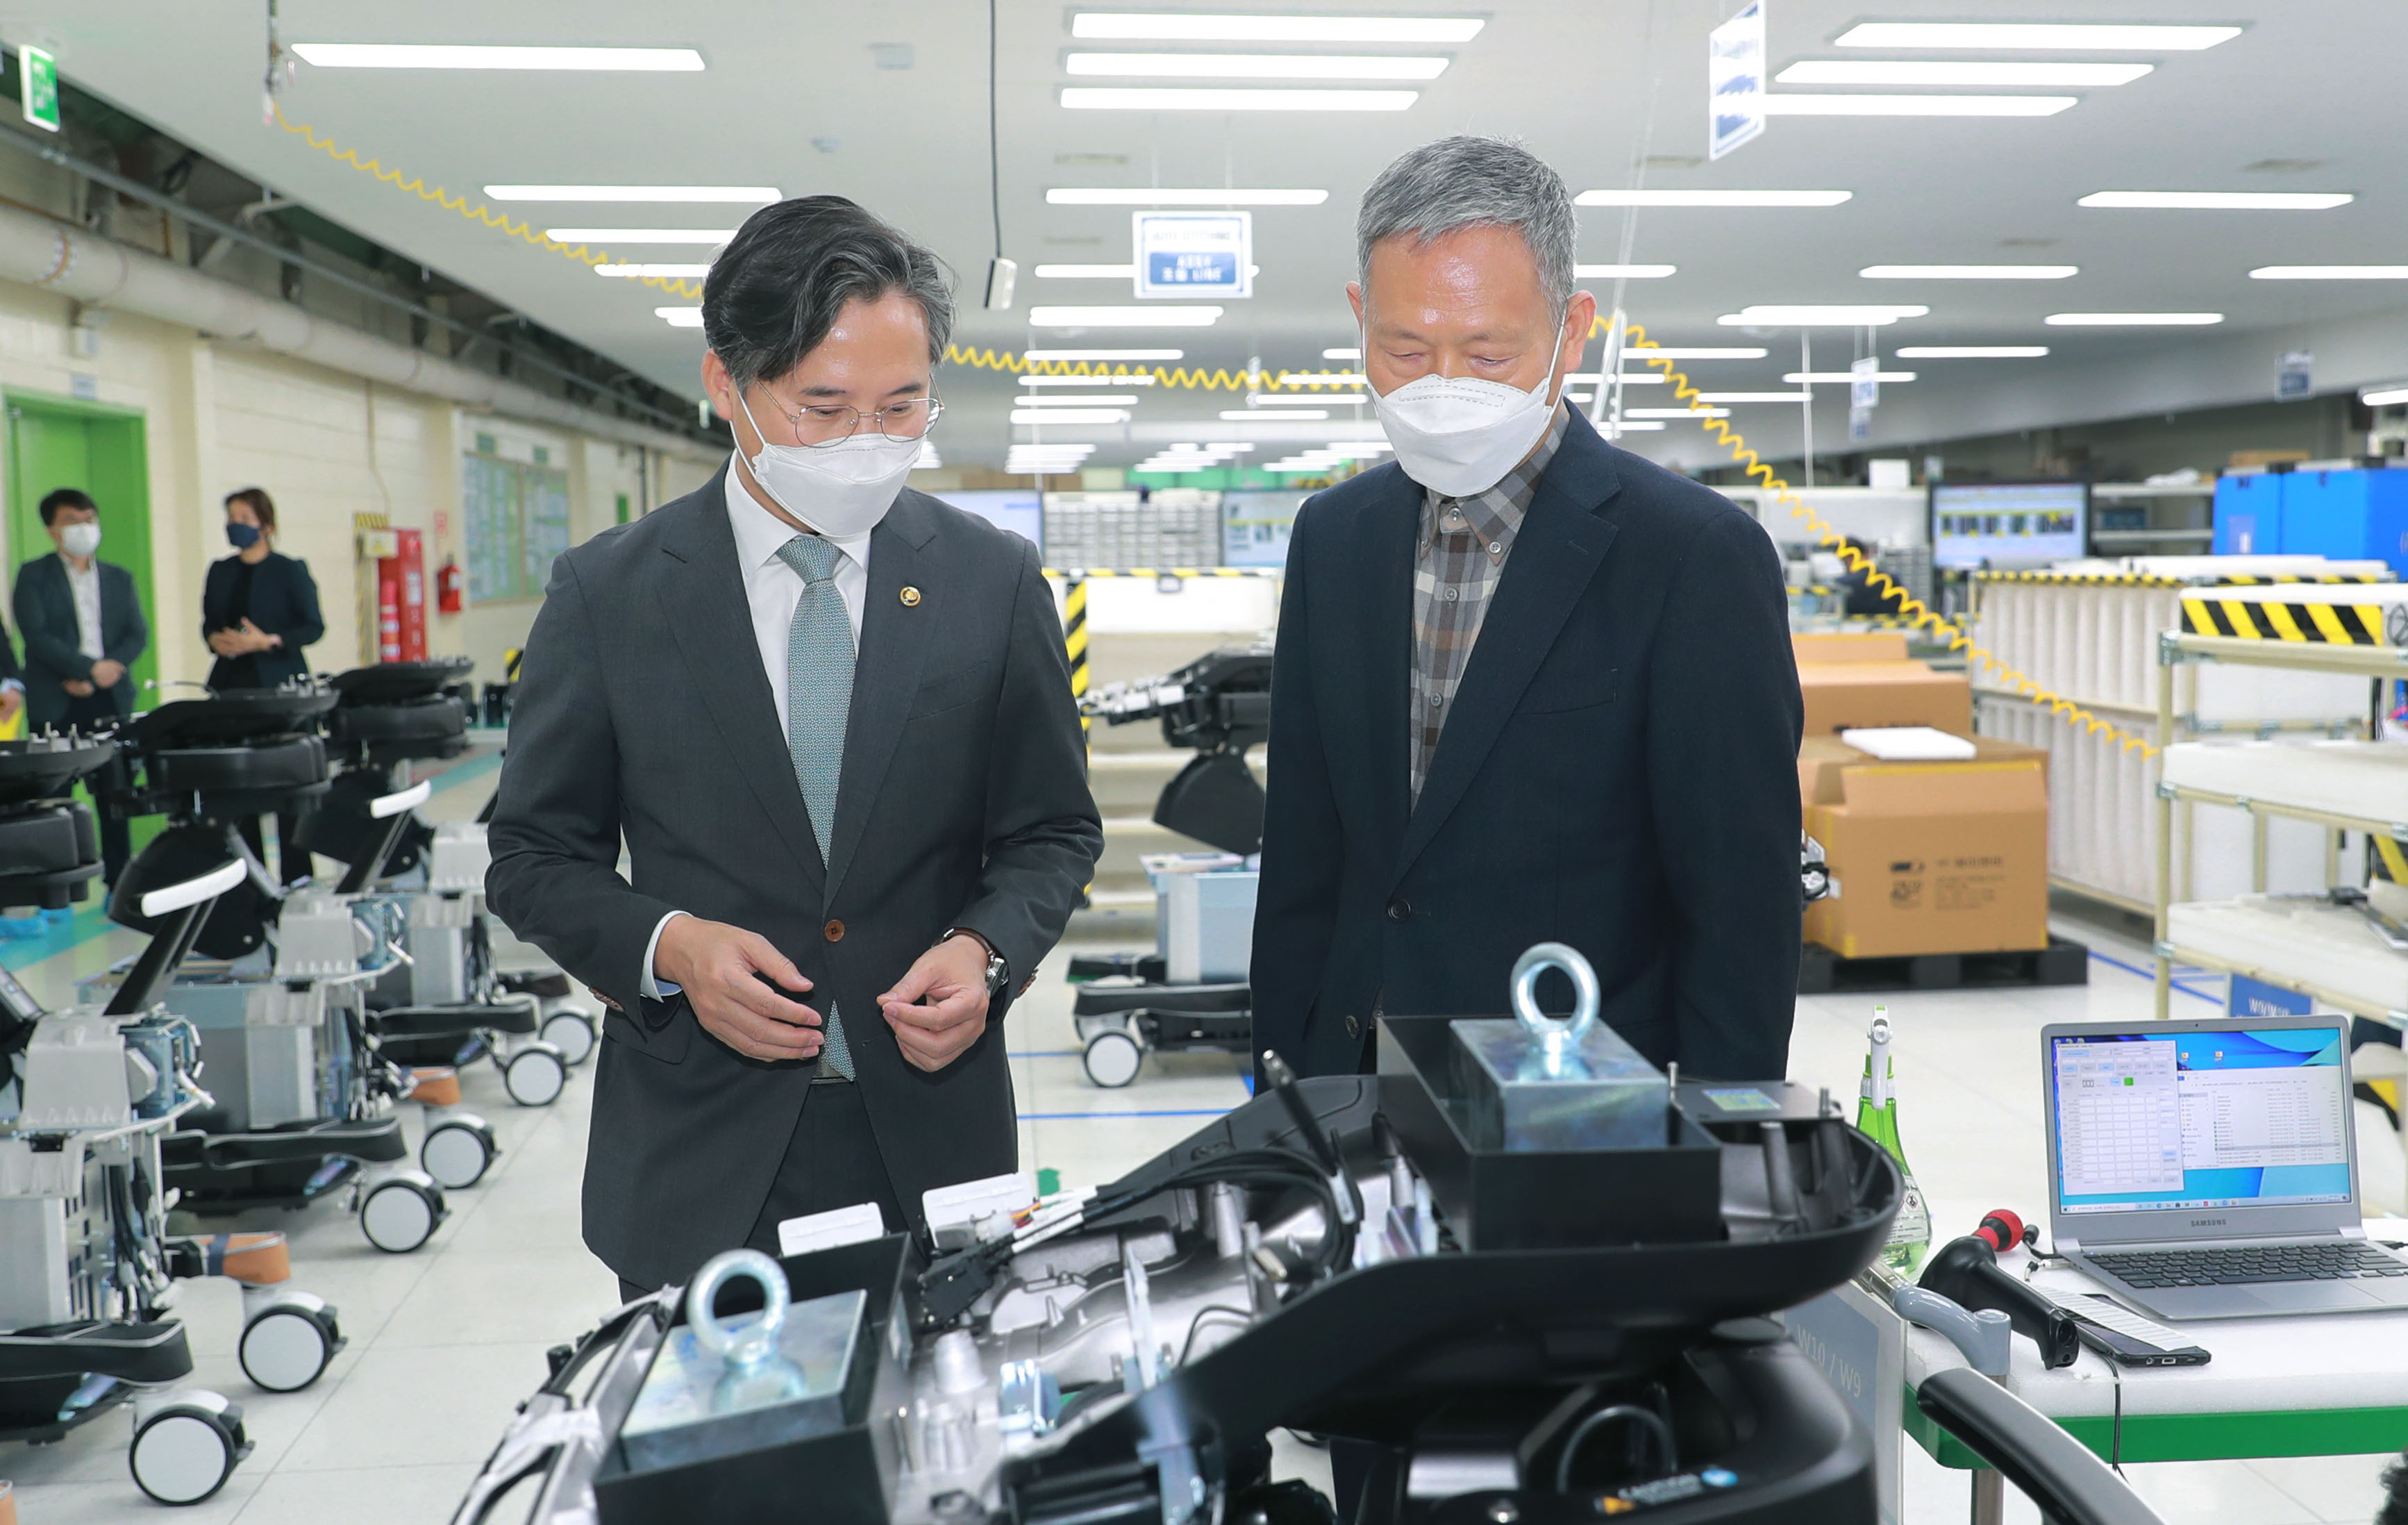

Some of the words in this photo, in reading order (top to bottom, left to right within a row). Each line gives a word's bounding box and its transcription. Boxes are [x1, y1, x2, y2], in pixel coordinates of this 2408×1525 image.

[2191, 1219, 2227, 1227] SAMSUNG
[1796, 1324, 1825, 1367] W10
[1829, 1353, 1837, 1378] /
[1839, 1358, 1861, 1399] W9
